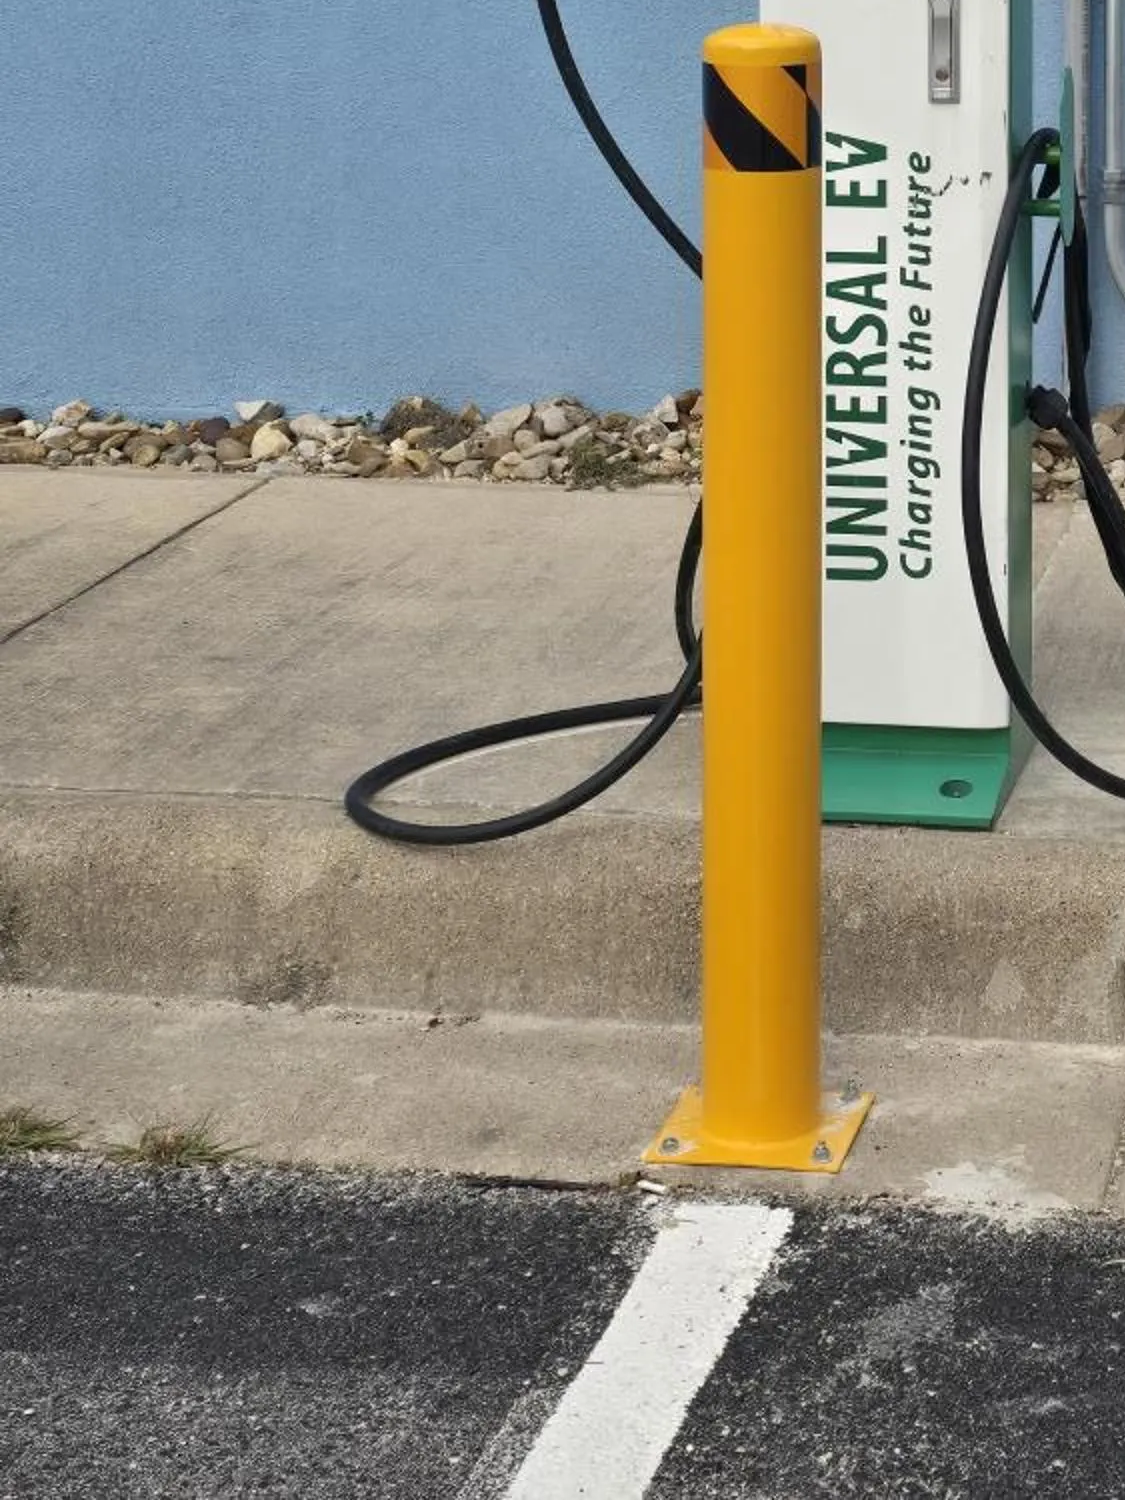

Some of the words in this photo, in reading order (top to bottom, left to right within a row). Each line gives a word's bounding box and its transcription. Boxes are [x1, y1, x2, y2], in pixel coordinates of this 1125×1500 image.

[825, 130, 888, 208] EV
[899, 149, 934, 291] Future
[900, 301, 934, 371] the
[825, 235, 888, 582] UNIVERSAL
[899, 385, 941, 580] Charging
